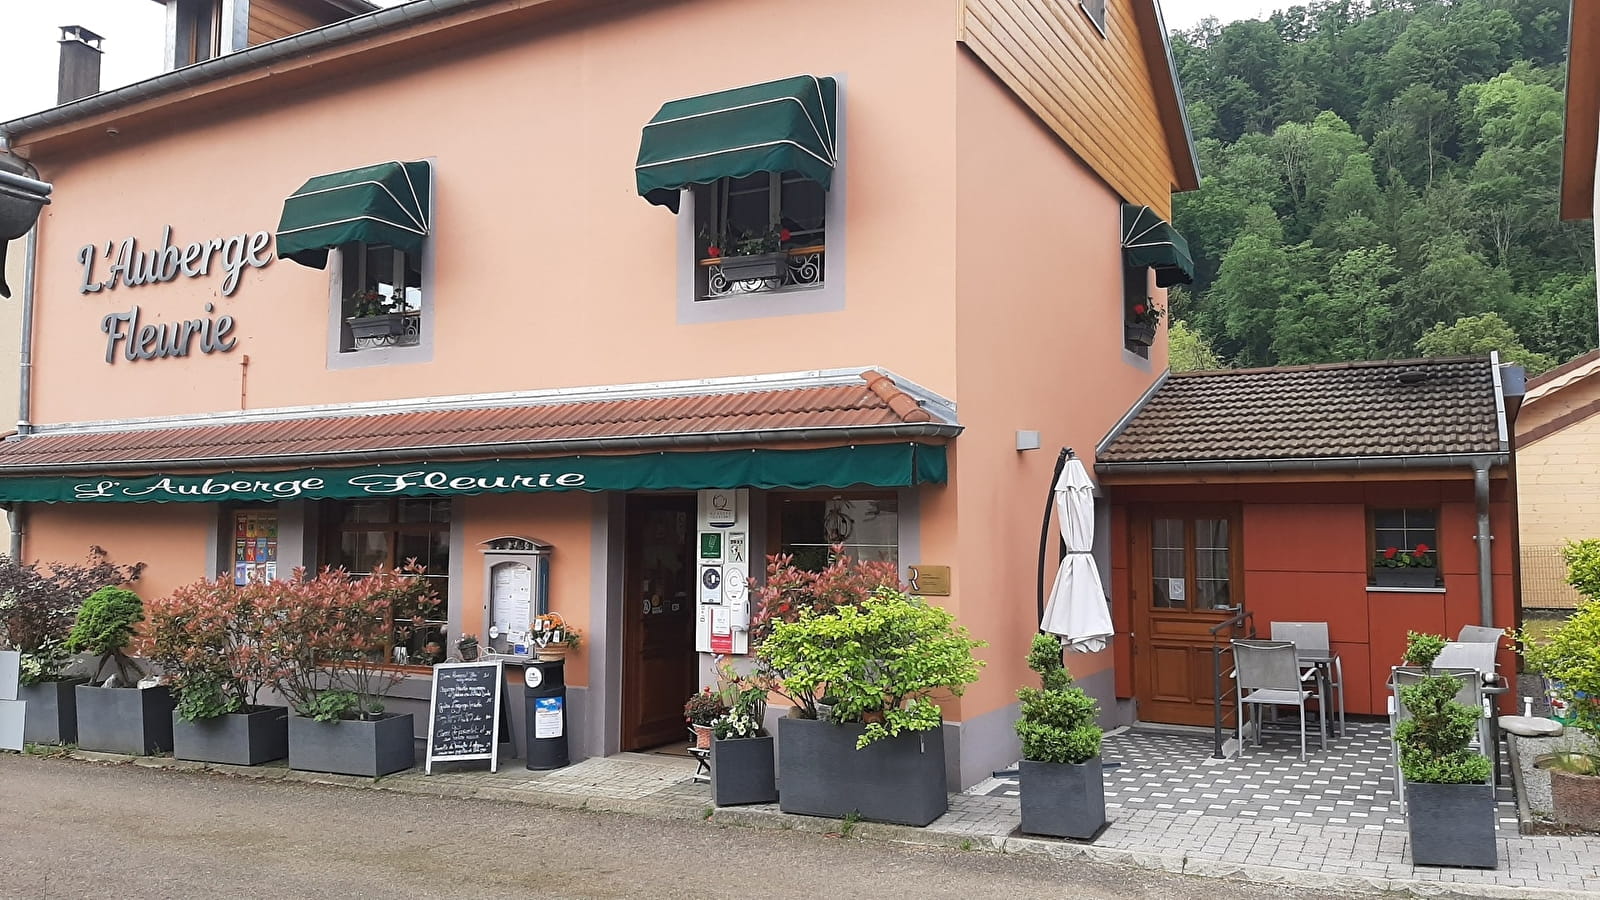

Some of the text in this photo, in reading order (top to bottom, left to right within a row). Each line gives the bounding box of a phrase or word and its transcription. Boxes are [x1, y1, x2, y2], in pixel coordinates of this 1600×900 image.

[78, 225, 272, 296] L'Auberge
[101, 303, 236, 364] Fleurie
[74, 471, 586, 498] L'Auberge Fleurie
